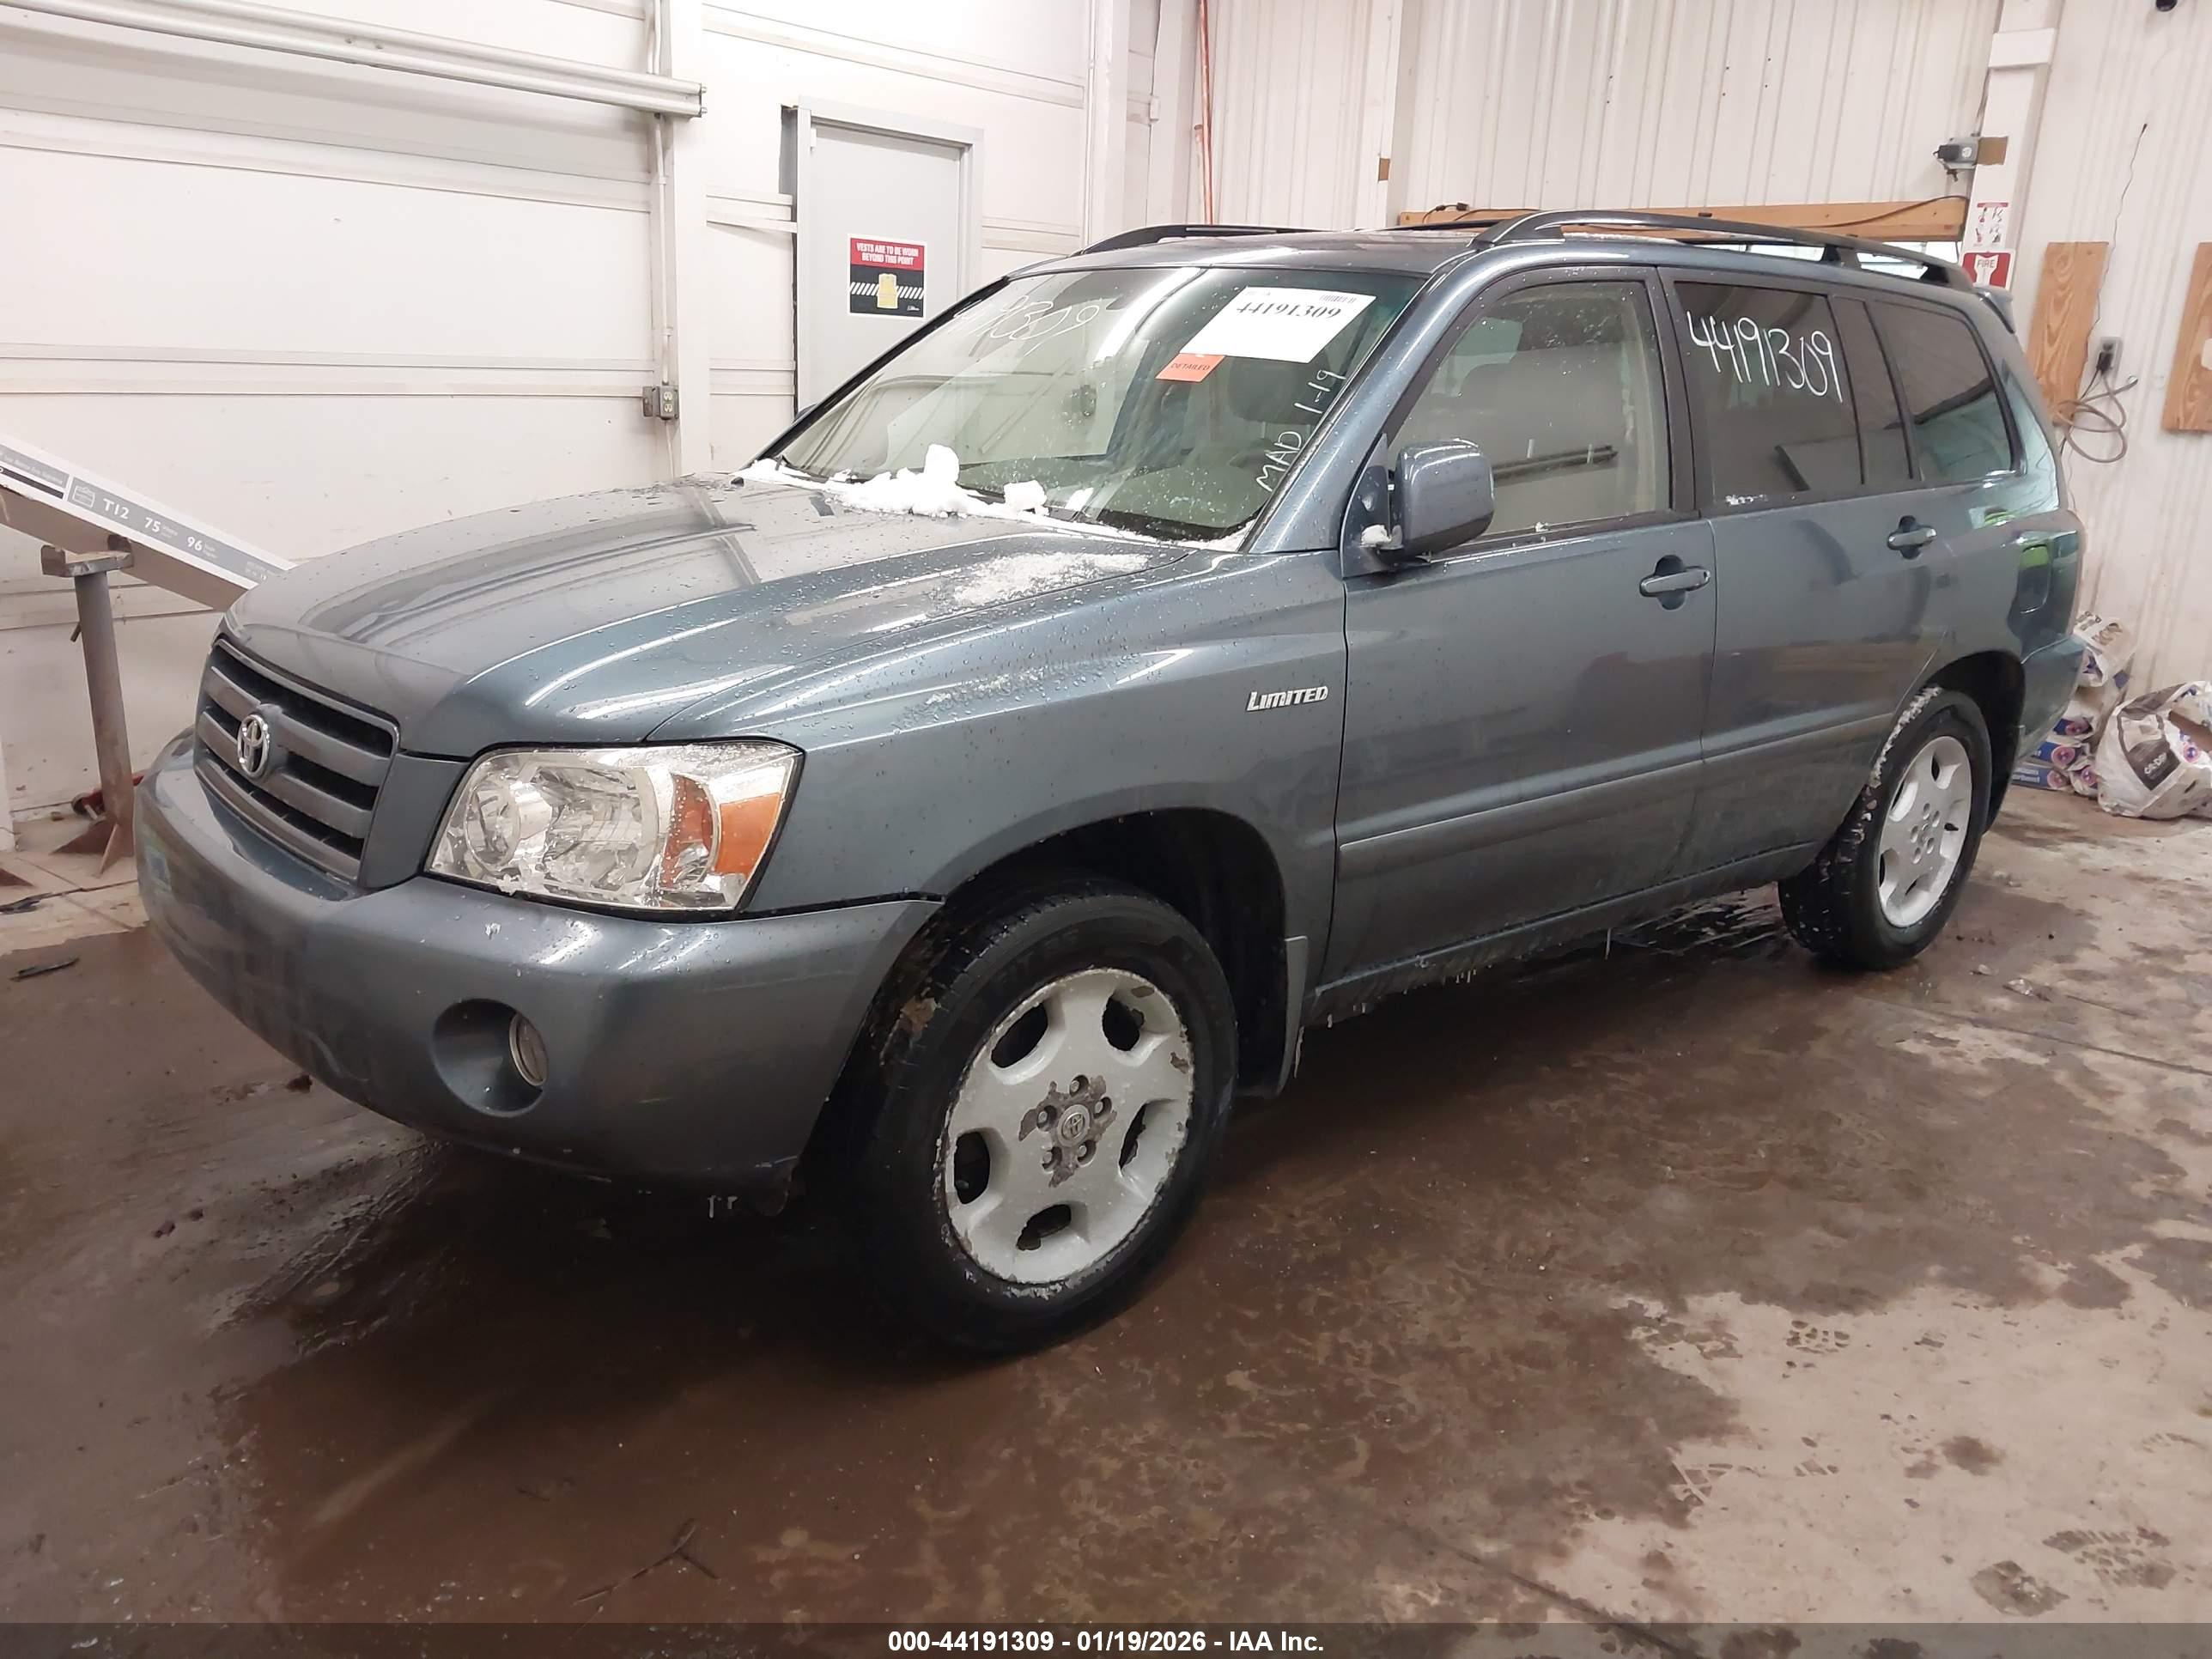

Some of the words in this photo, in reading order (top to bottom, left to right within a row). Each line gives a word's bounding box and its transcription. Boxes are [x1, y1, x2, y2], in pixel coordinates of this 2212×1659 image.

[856, 243, 874, 252] VESTS
[875, 245, 886, 253] ARE
[887, 246, 894, 254] TO
[895, 246, 902, 255] BE
[902, 247, 919, 257] WORN
[862, 252, 884, 262] BEYOND
[885, 255, 896, 264] THIS
[898, 257, 914, 265] POINT
[1237, 301, 1341, 319] 44191309
[1686, 310, 1844, 404] 44191309
[1170, 362, 1211, 371] DETAILED
[1255, 430, 1303, 492] MAD
[1293, 369, 1347, 415] 1-19
[144, 517, 161, 532] 75
[187, 536, 203, 551] 96
